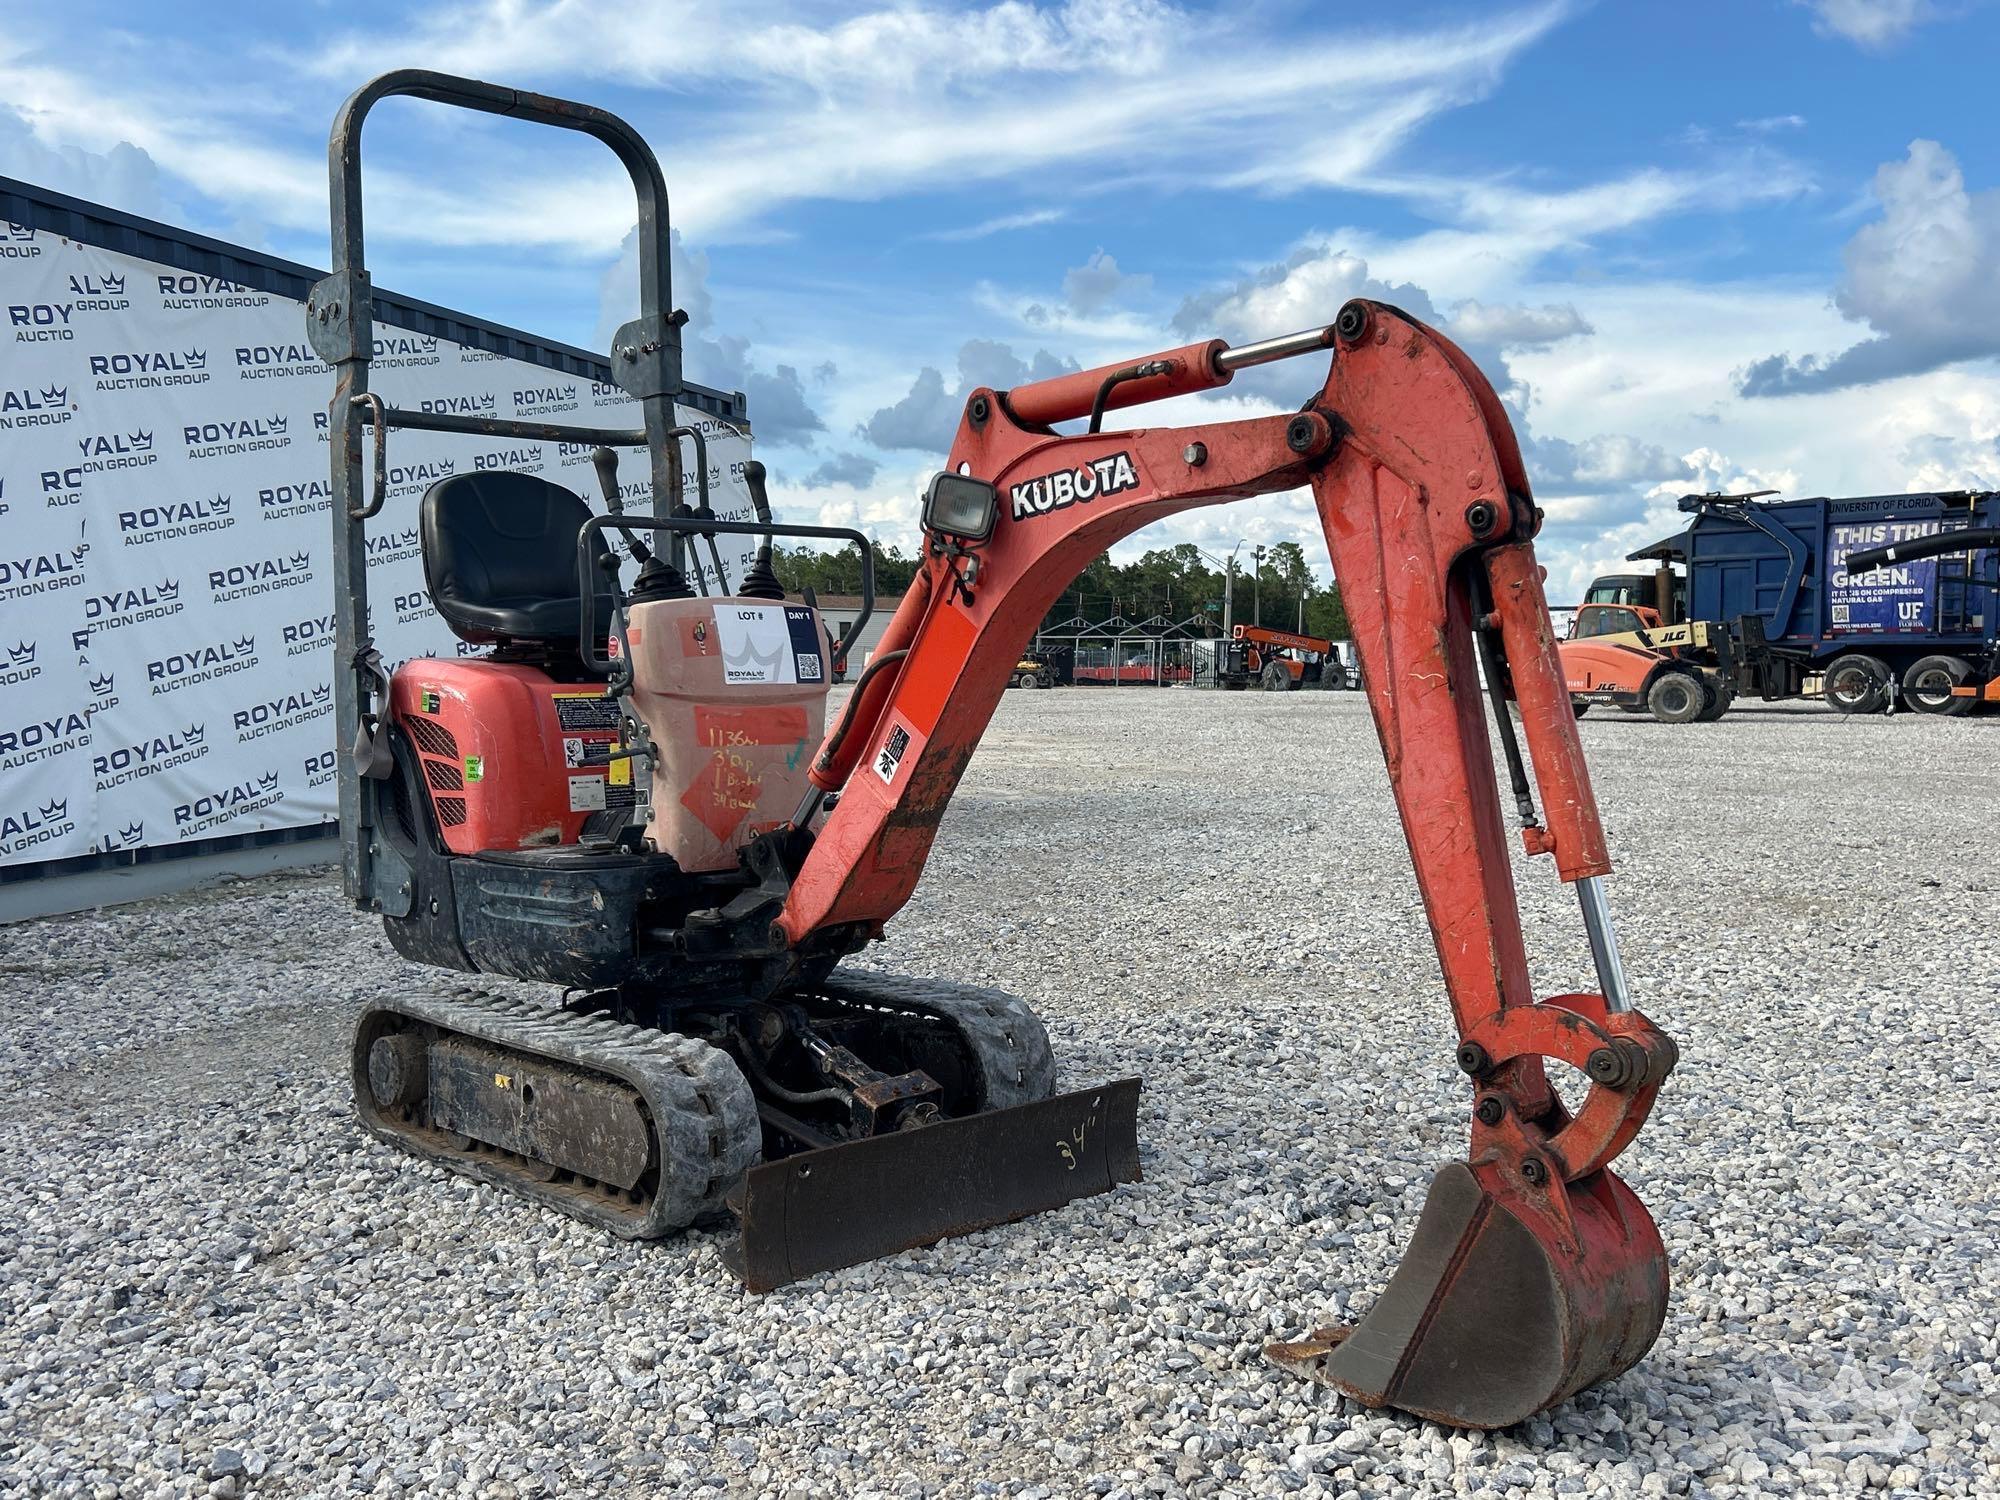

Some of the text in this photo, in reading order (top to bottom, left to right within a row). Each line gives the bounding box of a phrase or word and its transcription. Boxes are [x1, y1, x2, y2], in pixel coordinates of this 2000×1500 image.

[76, 300, 130, 311] GROUP
[163, 297, 269, 310] AUCTION GROUP
[90, 352, 185, 375] ROYAL
[235, 345, 314, 366] ROYAL
[407, 356, 440, 367] GROUP
[96, 373, 210, 391] AUCTION GROUP
[240, 364, 336, 380] AUCTION GROUP
[421, 396, 481, 415] ROYAL
[513, 387, 565, 406] ROYAL
[594, 397, 625, 407] AUCTION
[16, 412, 72, 428] GROUP
[516, 402, 579, 417] AUCTION GROUP
[184, 419, 268, 445] ROYAL
[188, 437, 292, 460] AUCTION GROUP
[106, 454, 158, 470] GROUP
[474, 449, 530, 471] ROYAL
[1011, 455, 1136, 517] KUBOTA
[119, 500, 210, 532] ROYAL
[263, 503, 316, 521] AUCTION
[1830, 498, 1937, 514] UNIVERSITY OF FLORIDA
[124, 517, 235, 547] AUCTION GROUP
[1834, 524, 1887, 545] THIS
[386, 548, 422, 564] GROUP
[209, 558, 291, 590] ROYAL
[213, 572, 313, 604] AUCTION GROUP
[1861, 589, 1871, 597] ON
[1873, 588, 1924, 596] COMPRESSED
[136, 602, 184, 622] GROUP
[738, 612, 811, 620] LOT # DAY 1
[1898, 602, 1923, 620] UF
[1660, 631, 1686, 643] JLG
[147, 643, 235, 682] ROYAL
[152, 657, 259, 696] AUCTION GROUP
[1596, 683, 1616, 691] JLG
[233, 692, 313, 730] ROYAL
[238, 703, 334, 744] AUCTION GROUP
[2, 739, 75, 771] AUCTION
[93, 734, 184, 778] ROYAL
[95, 745, 209, 793] AUCTION GROUP
[173, 780, 262, 825] ROYAL
[180, 791, 285, 839] AUCTION GROUP
[15, 821, 75, 852] GROUP
